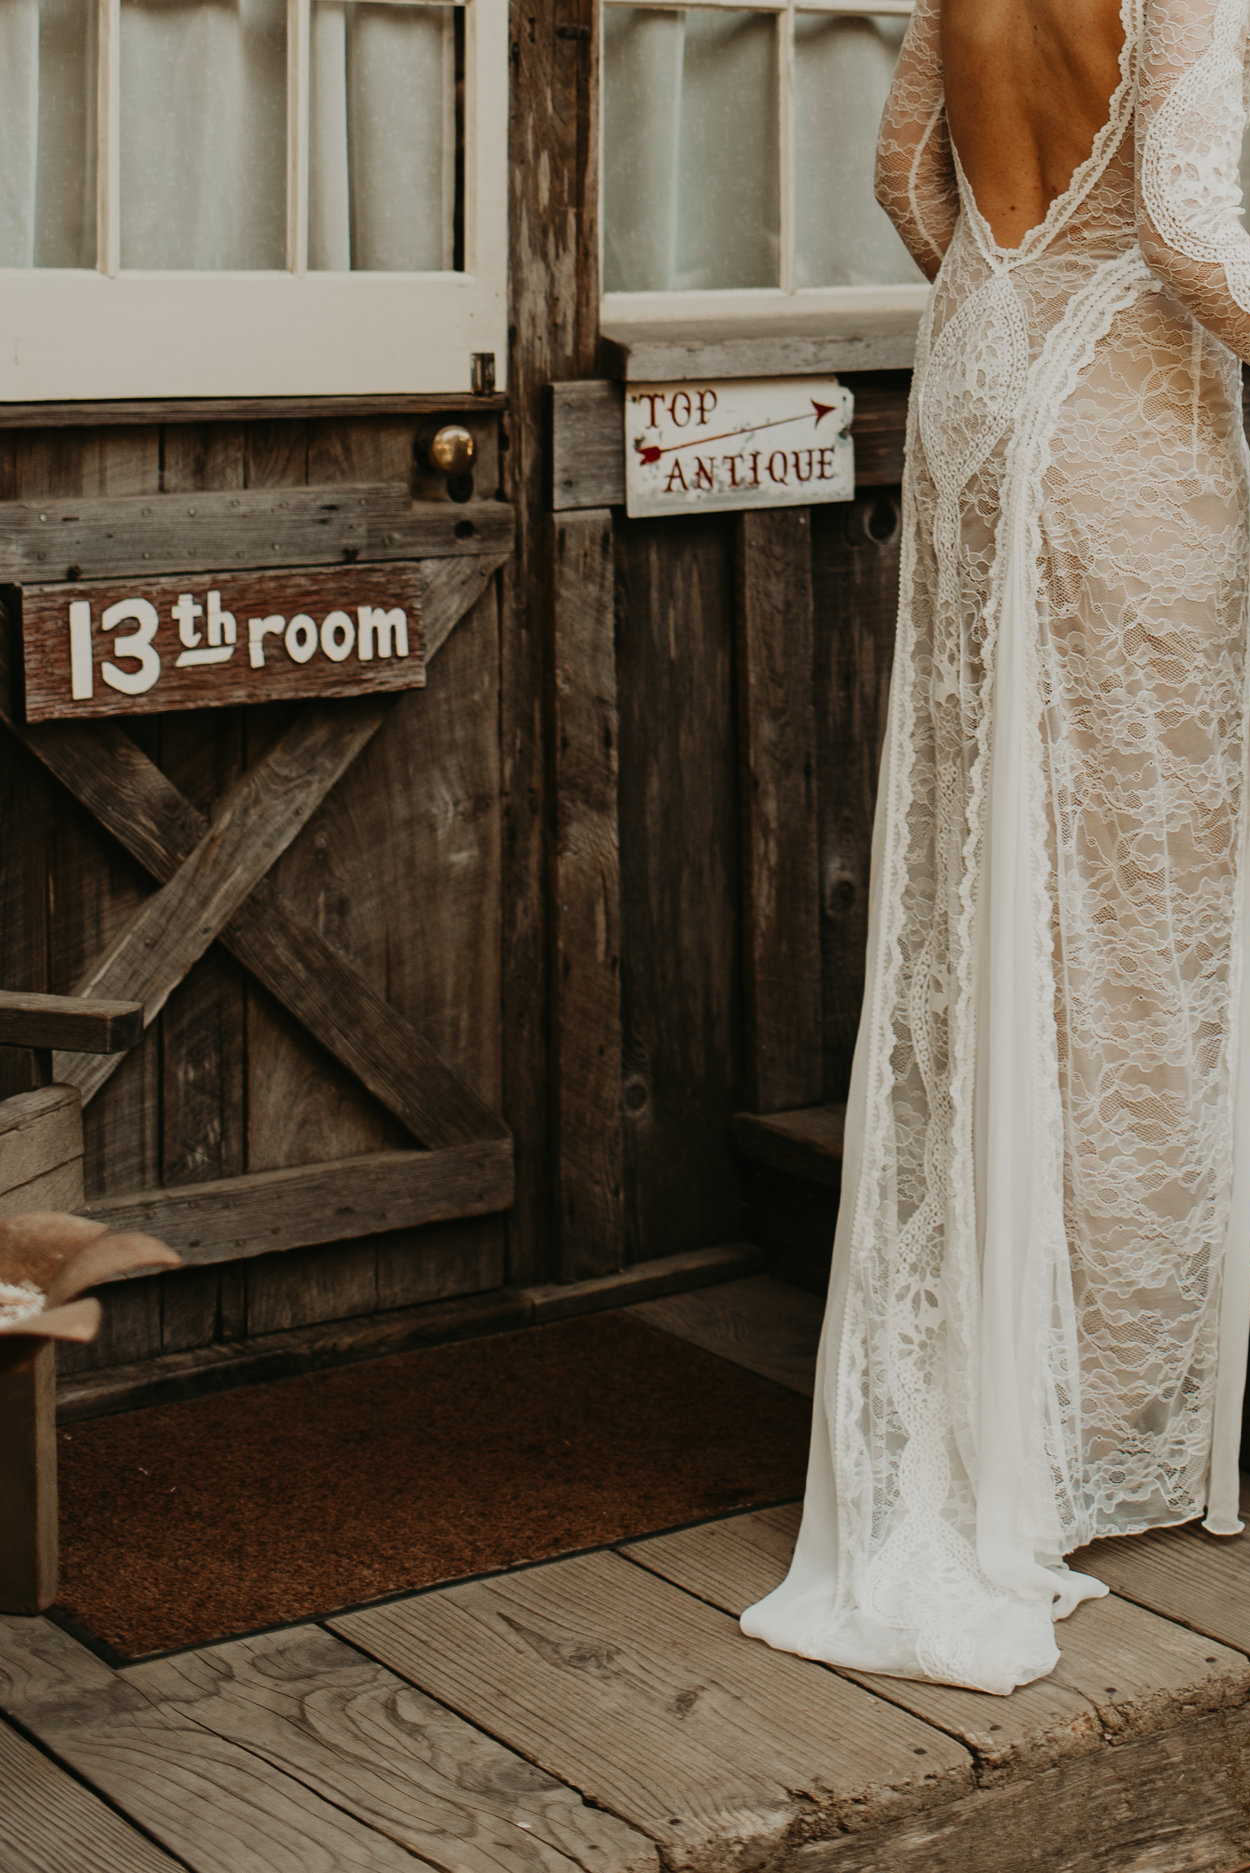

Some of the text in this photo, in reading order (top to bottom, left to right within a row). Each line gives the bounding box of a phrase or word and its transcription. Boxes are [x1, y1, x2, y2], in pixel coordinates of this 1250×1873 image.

[639, 388, 718, 429] TOP
[663, 447, 836, 493] ANTIQUE
[249, 605, 410, 669] room
